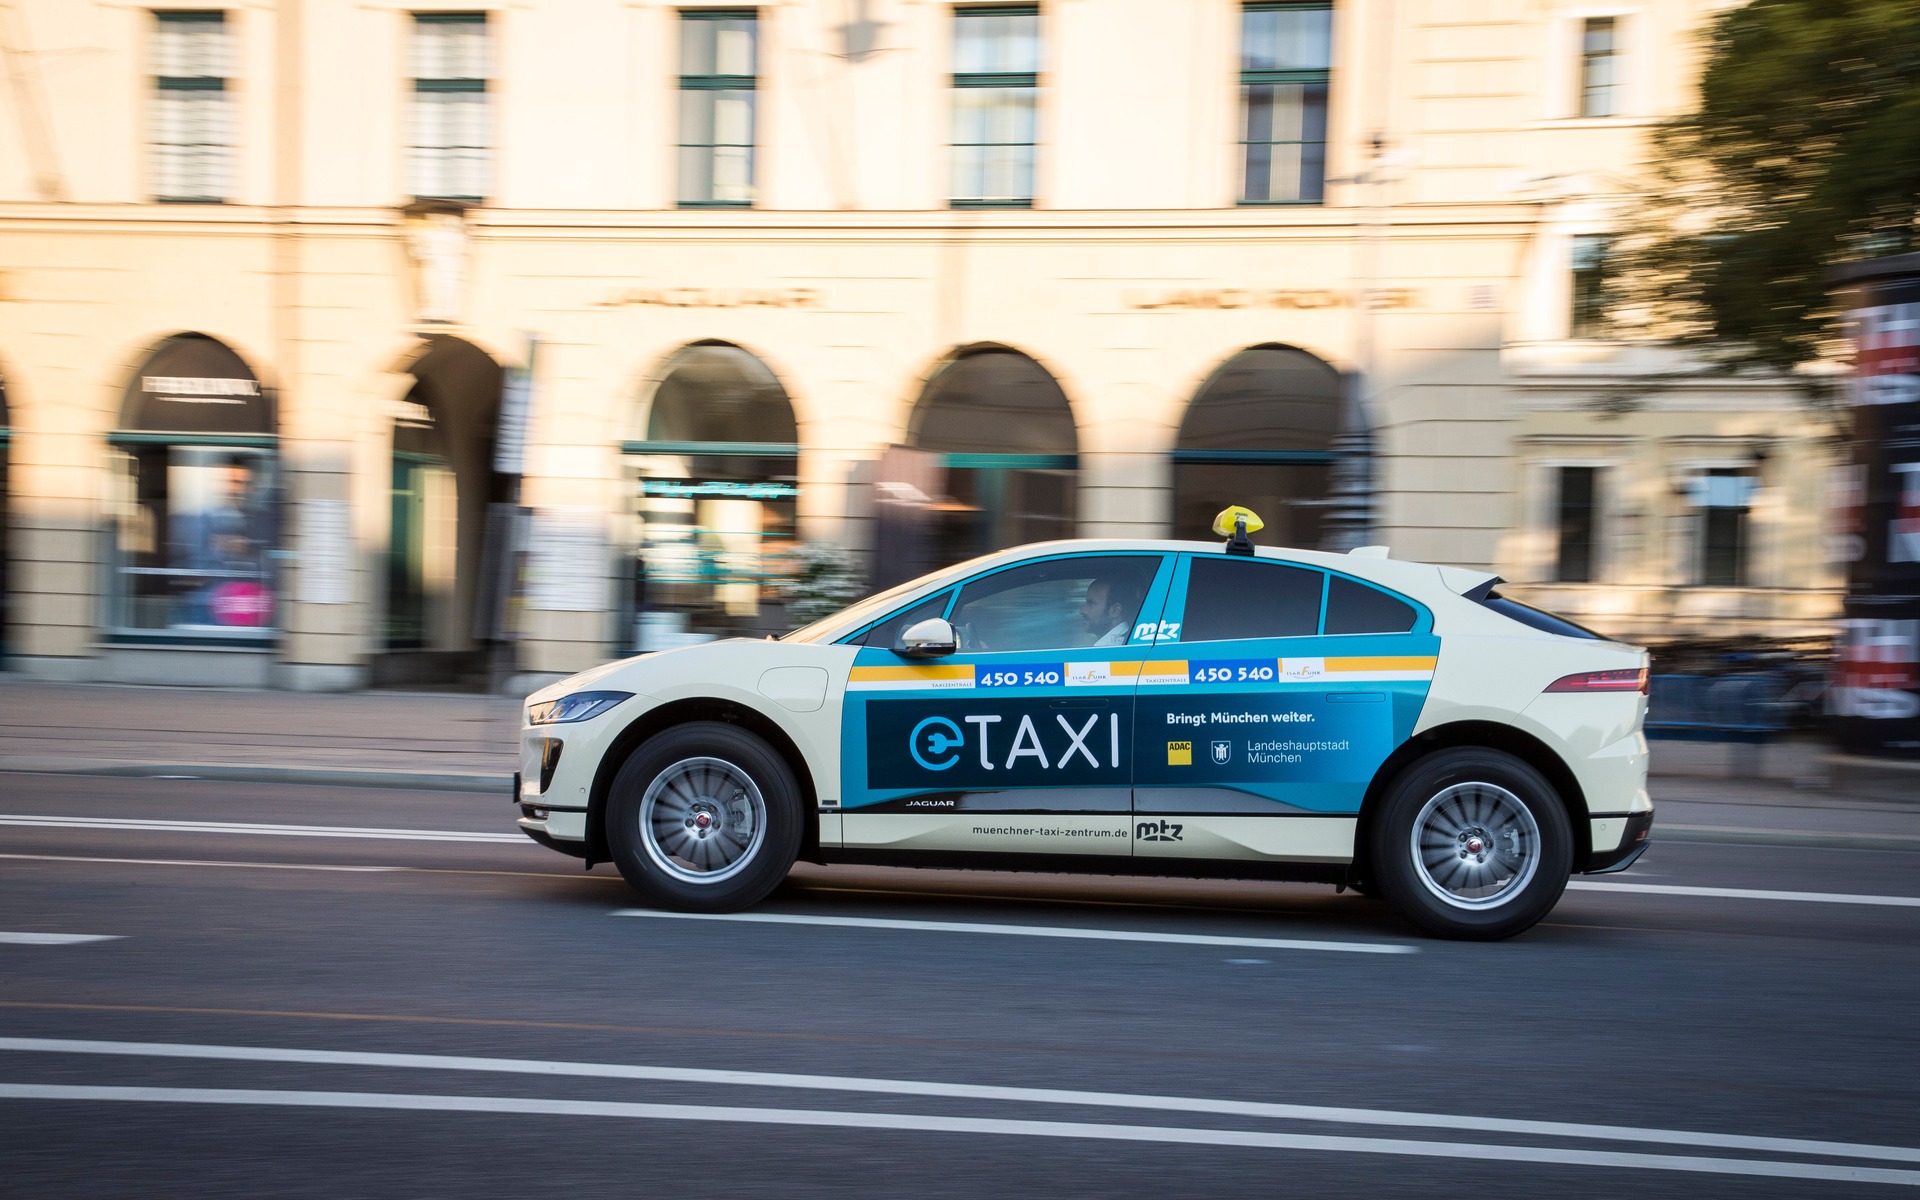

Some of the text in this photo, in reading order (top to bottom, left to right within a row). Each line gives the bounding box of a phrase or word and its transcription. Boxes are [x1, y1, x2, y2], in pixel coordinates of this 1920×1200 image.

[1133, 619, 1181, 641] mtz
[980, 671, 1059, 687] 450 540
[1194, 666, 1273, 682] 450 540
[1166, 711, 1316, 727] Bringt München weiter.
[1168, 742, 1191, 751] ADAC
[1247, 740, 1350, 752] Landeshauptstadt
[1247, 752, 1302, 763] München
[972, 825, 1128, 838] muenchner-taxi-zentrum.de
[1136, 819, 1184, 842] mtz
